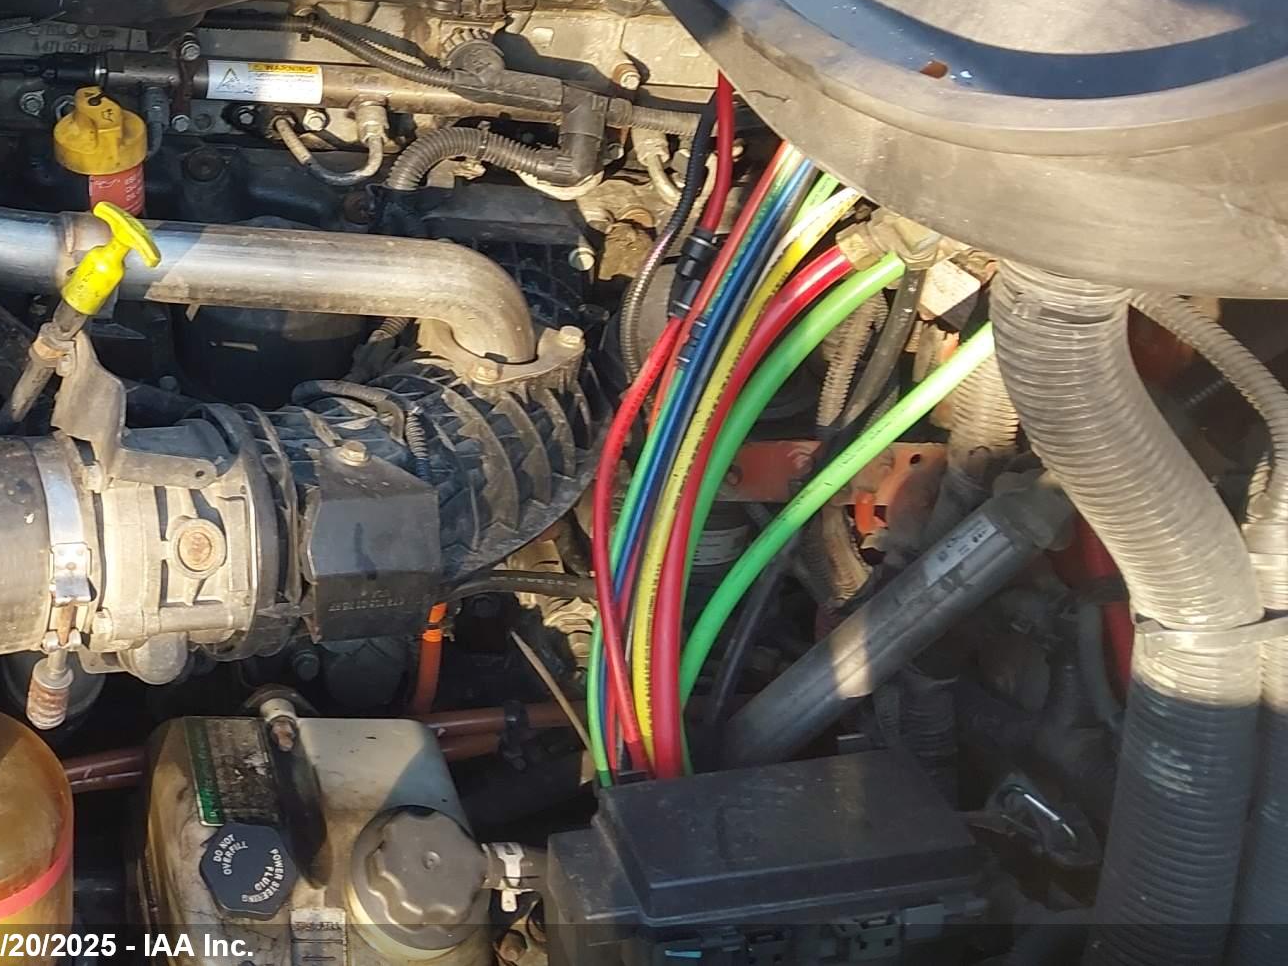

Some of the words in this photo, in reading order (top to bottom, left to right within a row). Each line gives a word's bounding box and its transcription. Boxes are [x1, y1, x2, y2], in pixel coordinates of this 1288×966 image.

[265, 64, 313, 73] WARNING
[218, 833, 236, 849] NOT
[213, 849, 224, 863] DO
[222, 840, 248, 875] OVERFILL
[269, 848, 285, 881] POWER
[254, 866, 274, 891] FLUID
[241, 881, 281, 903] STEERING
